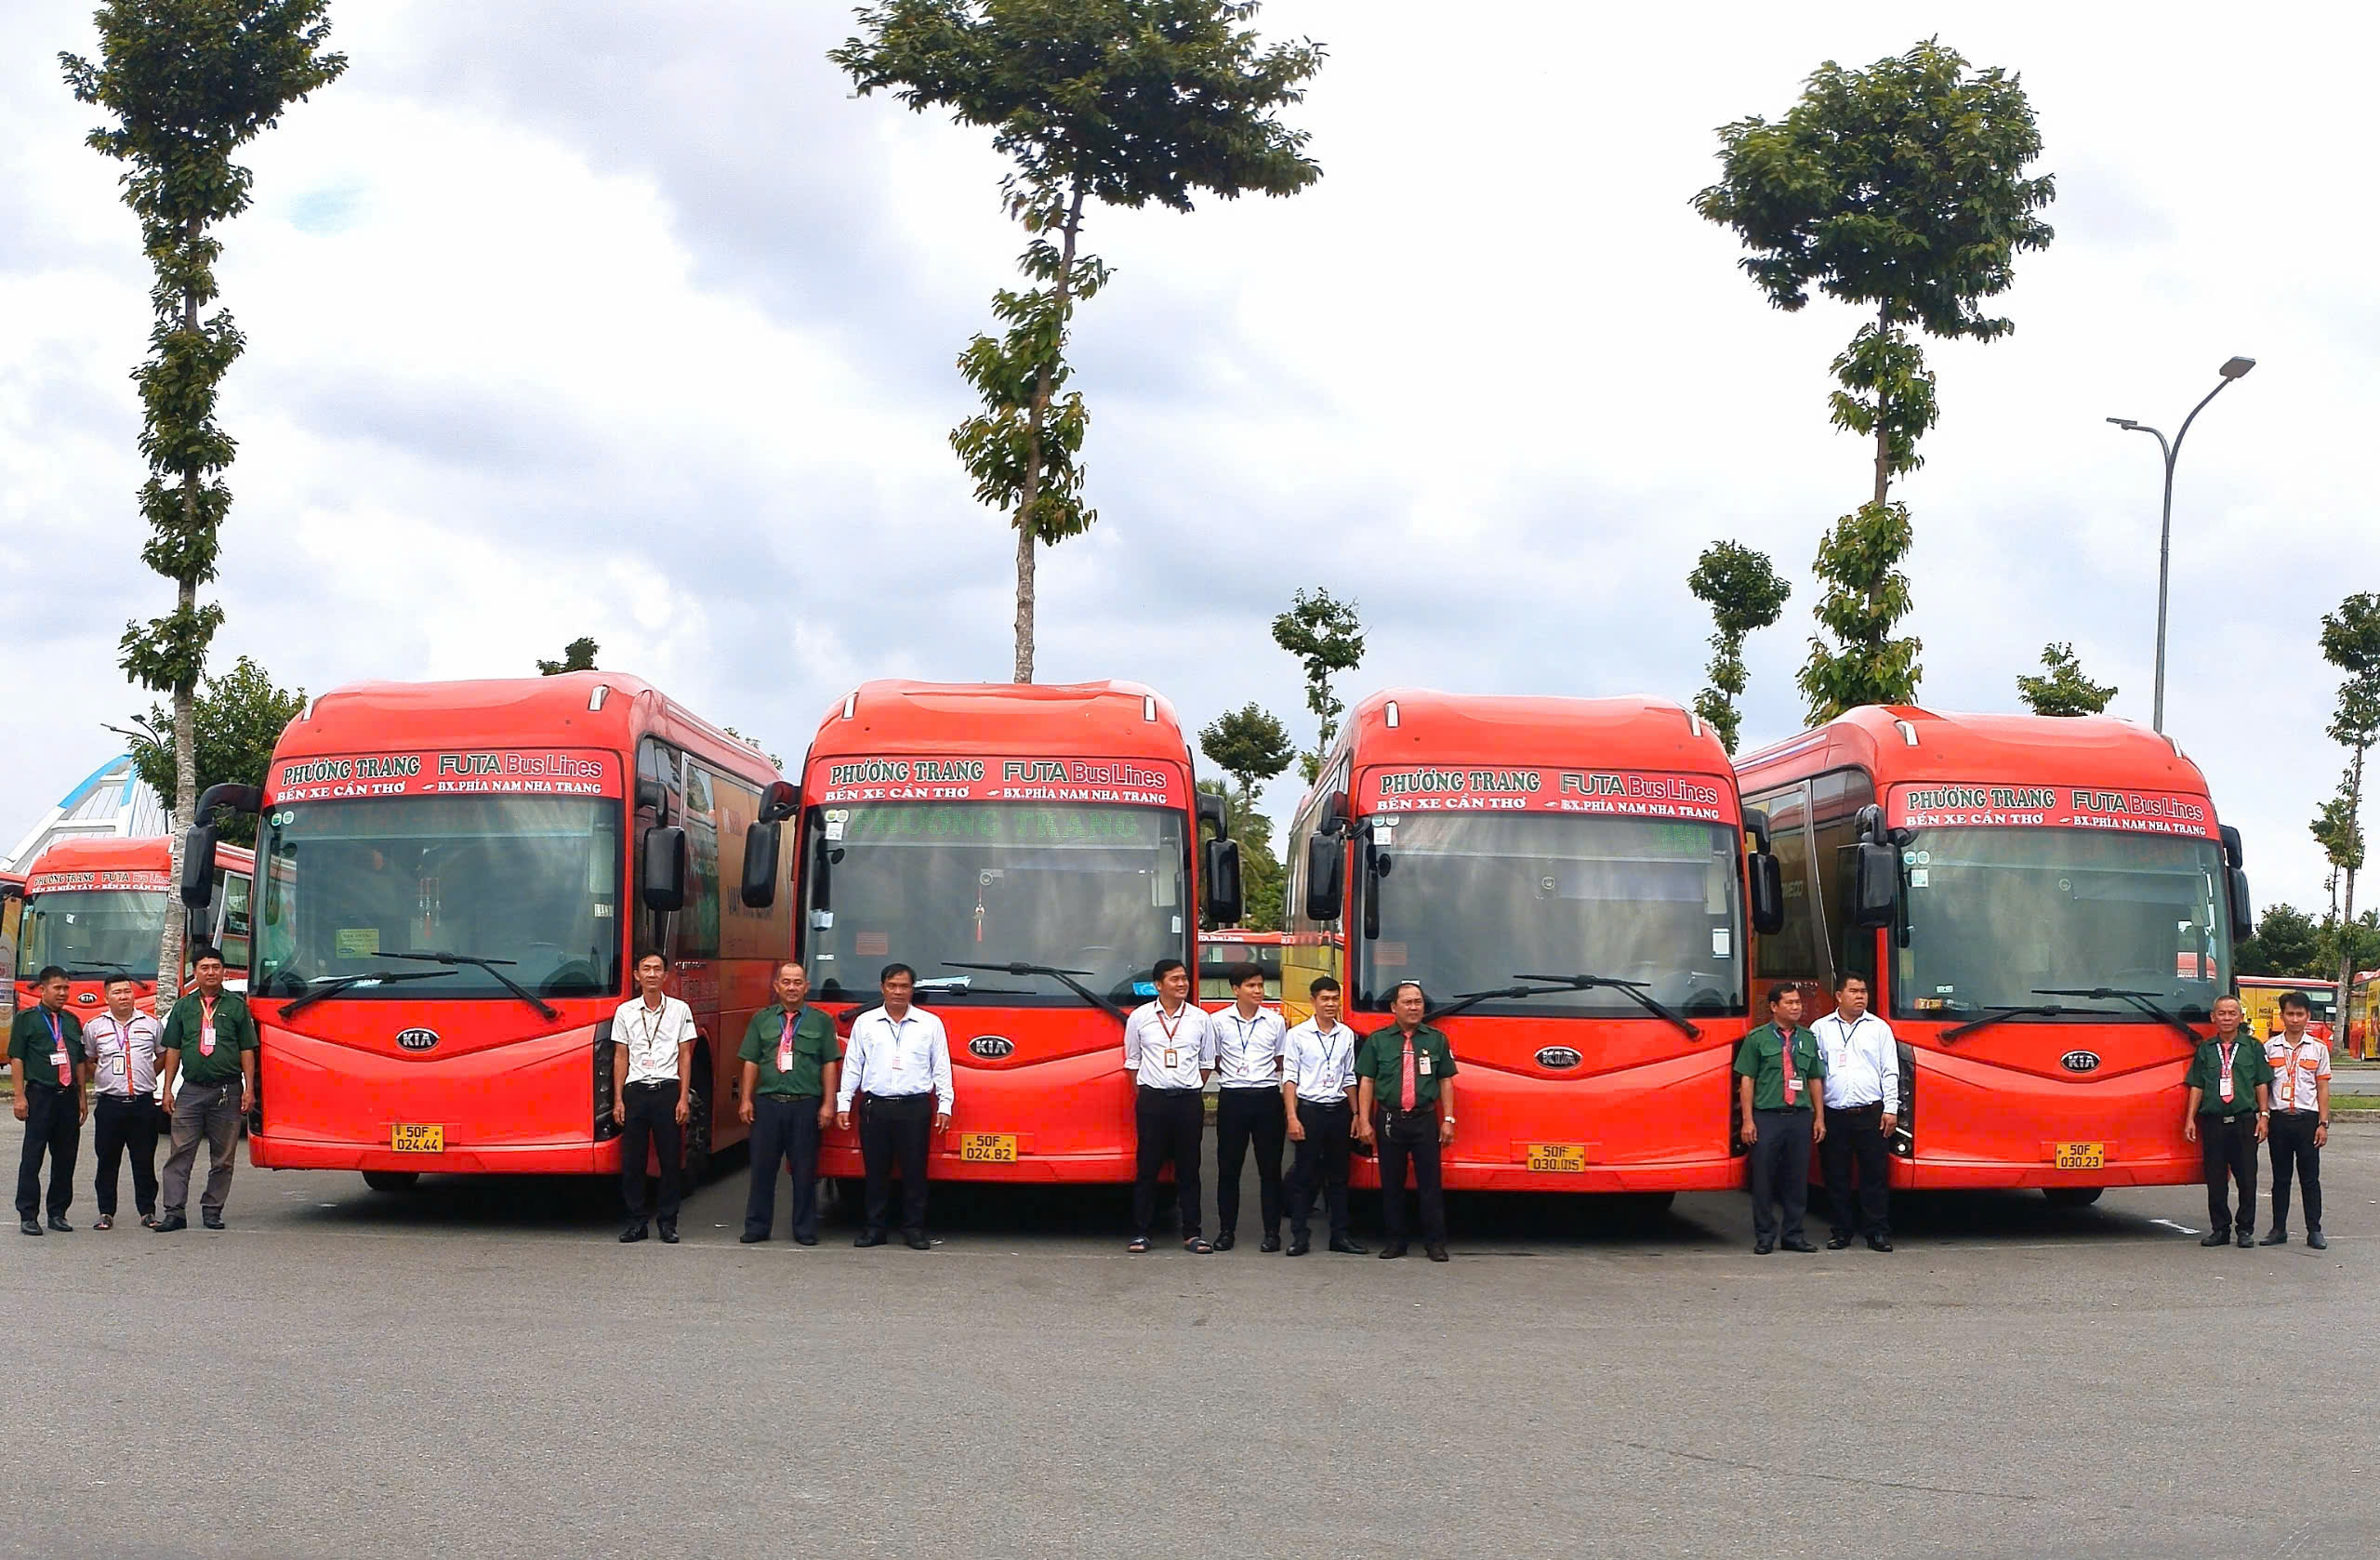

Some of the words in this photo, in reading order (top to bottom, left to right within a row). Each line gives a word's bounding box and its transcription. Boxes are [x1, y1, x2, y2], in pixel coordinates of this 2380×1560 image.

[281, 758, 352, 787] PHƯƠNG
[355, 755, 421, 779] TRANG
[438, 753, 503, 775] FUTA
[506, 753, 545, 775] Bus
[546, 755, 602, 778] Lines
[829, 758, 910, 786] PHƯƠNG
[914, 760, 985, 783] TRANG
[1003, 760, 1069, 783] FUTA
[1072, 760, 1110, 784] Bus
[1112, 763, 1168, 789] Lines
[276, 787, 306, 801] BẾN
[309, 787, 330, 799] XE
[333, 781, 367, 797] CẦN
[372, 781, 405, 794] THƠ
[492, 780, 522, 792] NAM
[523, 781, 551, 792] NHA
[555, 782, 602, 794] TRANG
[1380, 767, 1464, 795] PHƯƠNG
[1469, 770, 1541, 793] TRANG
[1559, 772, 1626, 796] FUTA
[1628, 775, 1666, 798] Bus
[1667, 777, 1718, 804] Lines
[825, 786, 858, 801] BẾN
[862, 788, 886, 800] XE
[889, 784, 930, 799] CẦN
[932, 786, 970, 798] THƠ
[1059, 788, 1089, 800] NAM
[1091, 789, 1119, 801] NHA
[1122, 791, 1168, 804] TRANG
[1376, 796, 1412, 811] BẾN
[1417, 798, 1441, 809] XE
[1445, 793, 1485, 808] CẦN
[1488, 797, 1527, 808] THƠ
[1618, 802, 1646, 813] NAM
[1648, 803, 1676, 815] NHA
[1678, 805, 1719, 819] TRANG
[1908, 785, 1988, 811] PHƯƠNG
[1990, 788, 2056, 809] TRANG
[2071, 789, 2128, 813] FUTA
[2129, 794, 2162, 816] Bus
[2162, 797, 2203, 822] Lines
[1905, 812, 1940, 826] BẾN
[1944, 813, 1967, 825] XE
[1970, 809, 2006, 825] CẦN
[2010, 813, 2044, 825] THƠ
[2122, 818, 2146, 830] NAM
[2148, 820, 2171, 832] NHA
[2173, 823, 2206, 836] TRANG
[66, 872, 95, 883] TRANG
[102, 872, 129, 883] FUTA
[403, 1033, 432, 1046] KIA
[976, 1040, 1007, 1053] KIA
[1542, 1051, 1576, 1064] KIA
[2069, 1055, 2096, 1068] KIA
[406, 1127, 429, 1138] 50F
[397, 1139, 438, 1150] 024.44
[976, 1135, 1000, 1146] 50F
[967, 1147, 1012, 1160] 024.82
[2069, 1144, 2091, 1156] 50F
[2061, 1157, 2099, 1168] 030.23
